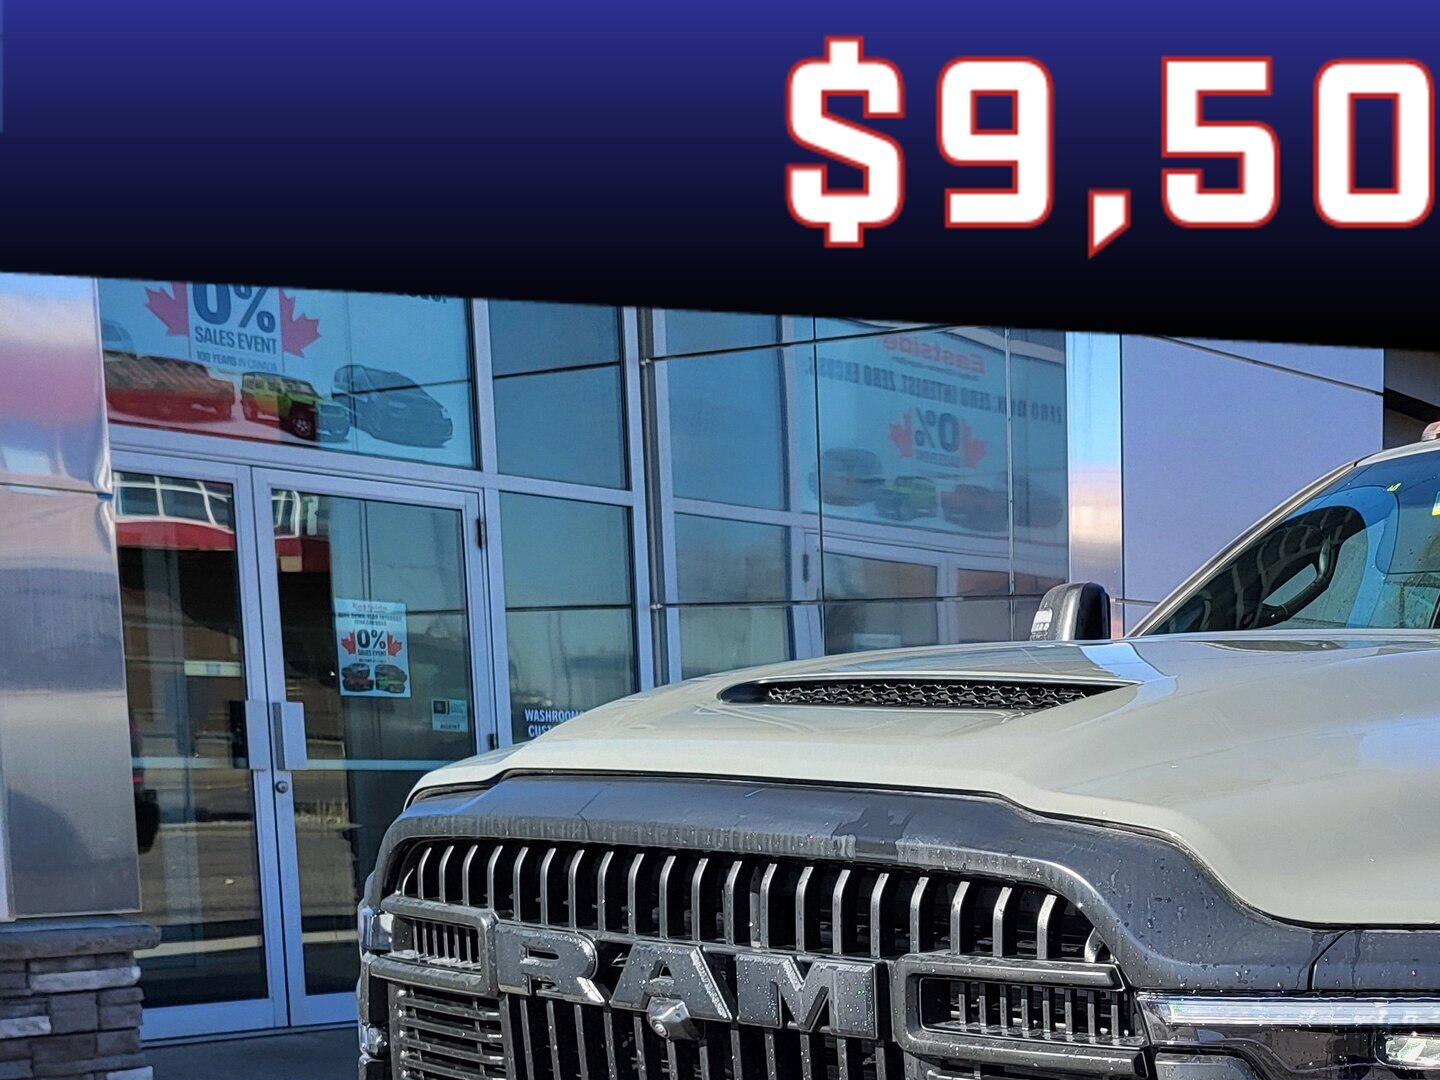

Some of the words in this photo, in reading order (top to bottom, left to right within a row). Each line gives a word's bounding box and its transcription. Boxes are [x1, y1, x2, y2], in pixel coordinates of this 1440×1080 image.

[192, 283, 276, 333] 0%
[195, 326, 235, 348] SALES
[238, 332, 277, 354] EVENT
[213, 353, 236, 366] YEARS
[357, 629, 386, 649] 0%
[524, 708, 584, 722] WASHROO
[496, 922, 884, 1040] RAM
